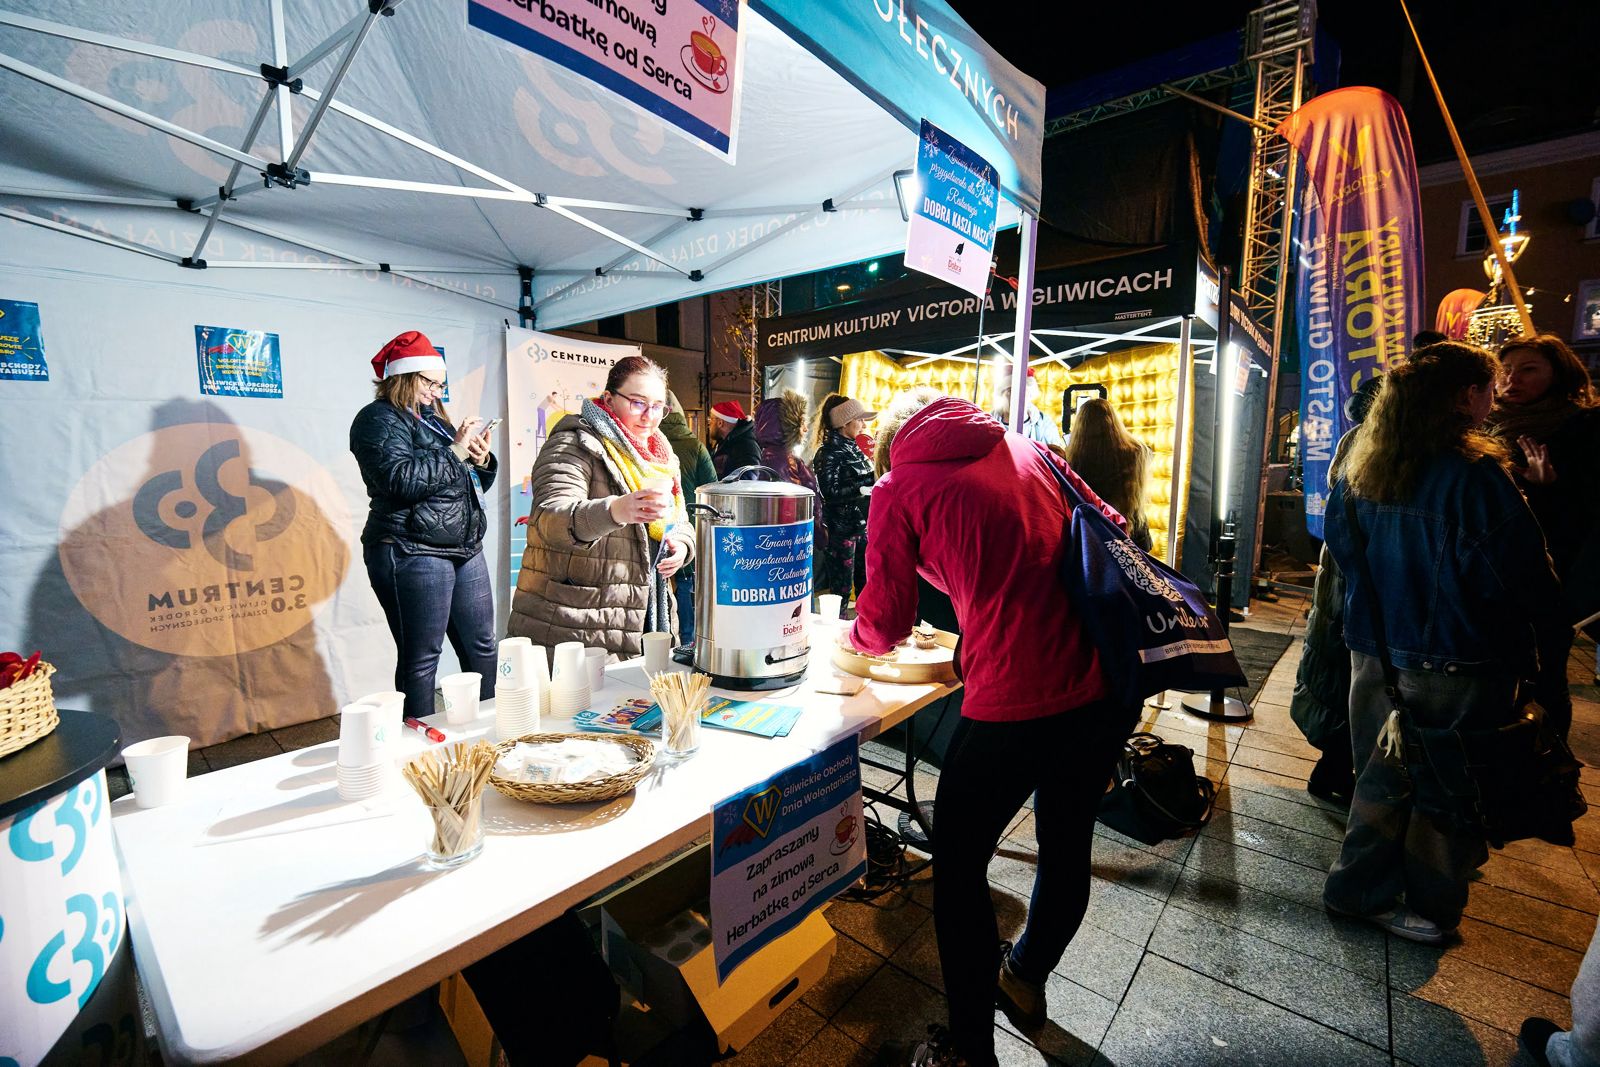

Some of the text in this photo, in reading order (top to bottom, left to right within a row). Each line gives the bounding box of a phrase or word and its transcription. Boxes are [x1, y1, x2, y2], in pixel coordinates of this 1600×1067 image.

[583, 0, 657, 48] imową
[507, 0, 692, 100] erbatkę od Serca
[873, 0, 1018, 140] OŁECZNYCH
[923, 197, 951, 225] DOBRA
[951, 212, 972, 236] KASZA
[972, 224, 989, 247] NASZA
[767, 324, 831, 348] CENTRUM
[834, 309, 901, 337] KULTURY
[907, 295, 995, 322] VICTORIA
[1001, 291, 1018, 310] W
[1031, 268, 1173, 306] GLIWICACH
[1114, 311, 1153, 320] MASTERTENT
[0, 362, 41, 371] BCHODY
[551, 350, 607, 366] CENTRUM
[755, 534, 793, 550] Zimową
[731, 587, 776, 603] DOBRA
[780, 582, 807, 600] KASZA
[783, 625, 802, 635] Dobra
[782, 769, 857, 816] Dnia Wolontariusza
[784, 754, 853, 798] Gliwickie Obchody
[746, 826, 820, 881] Zapraszamy
[752, 853, 815, 902] na zimową
[727, 862, 840, 945] Herbatkę od Serca
